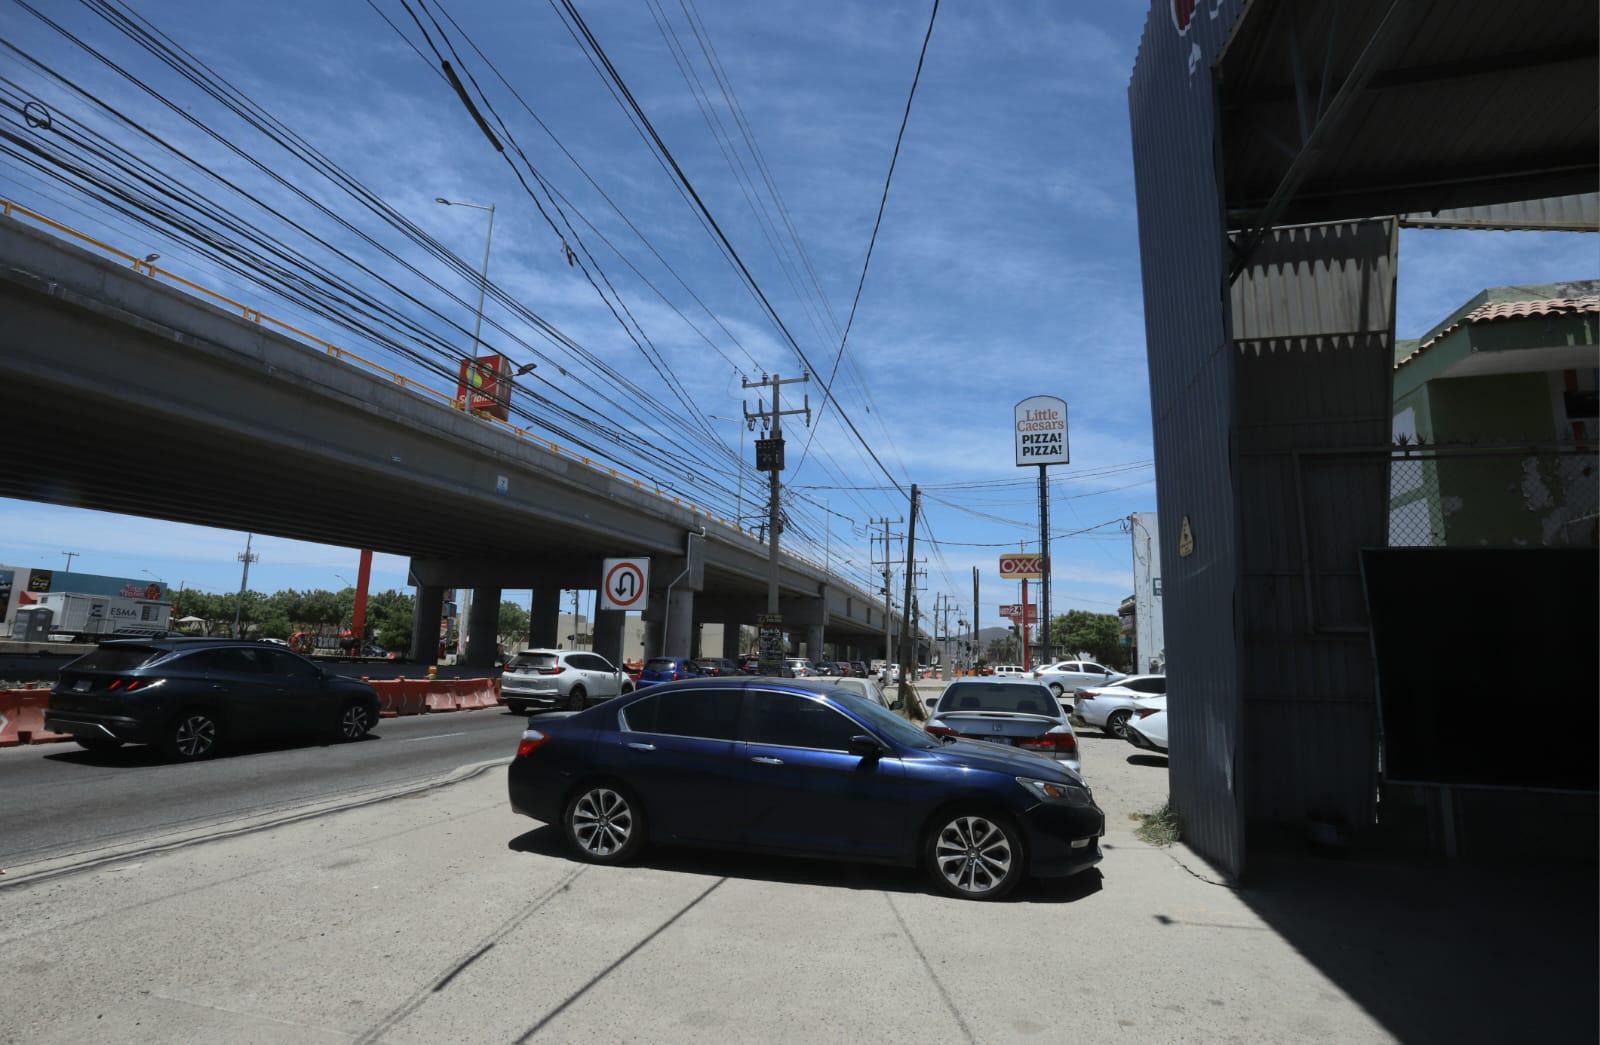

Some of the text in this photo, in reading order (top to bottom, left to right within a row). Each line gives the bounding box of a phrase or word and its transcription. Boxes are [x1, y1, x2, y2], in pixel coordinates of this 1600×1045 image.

[1026, 408, 1058, 422] Little
[1017, 420, 1064, 432] Caesars
[1022, 433, 1062, 445] PIZZA!
[1022, 445, 1062, 456] PIZZA!
[111, 607, 137, 617] ESMA
[1010, 606, 1021, 614] 24
